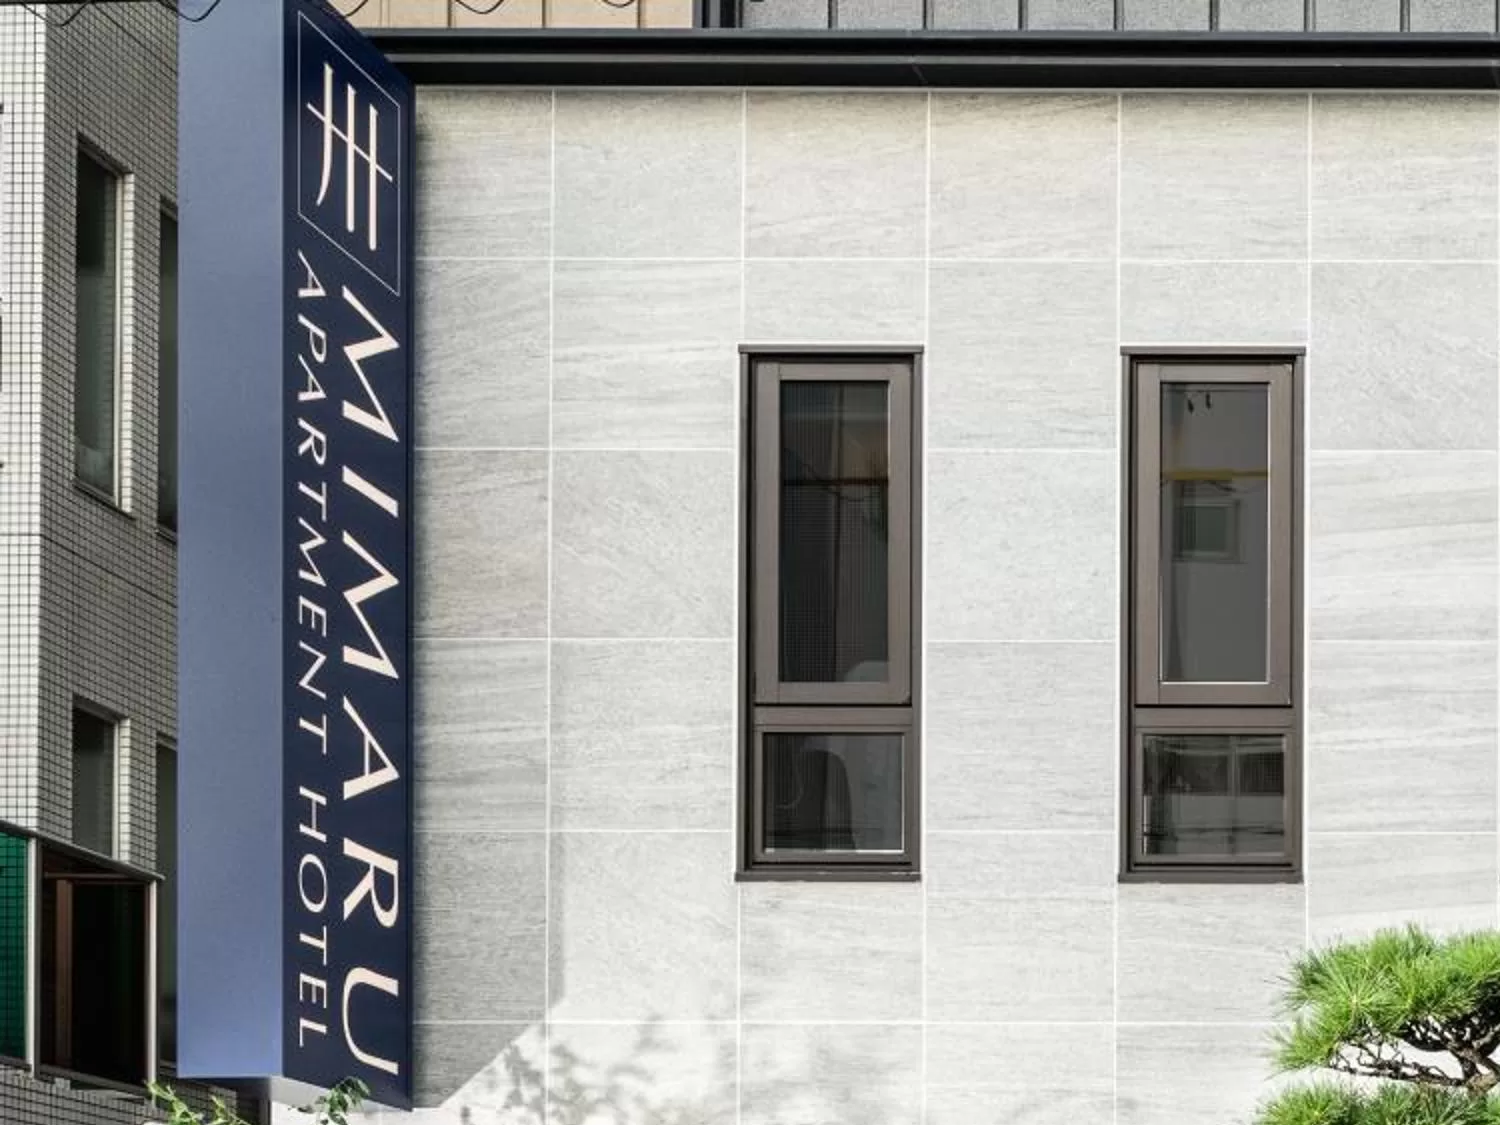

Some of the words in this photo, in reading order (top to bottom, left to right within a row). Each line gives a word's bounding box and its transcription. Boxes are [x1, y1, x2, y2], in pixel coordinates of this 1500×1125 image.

[298, 250, 328, 755] APARTMENT
[342, 285, 400, 1075] MIMARU
[298, 786, 328, 1047] HOTEL
